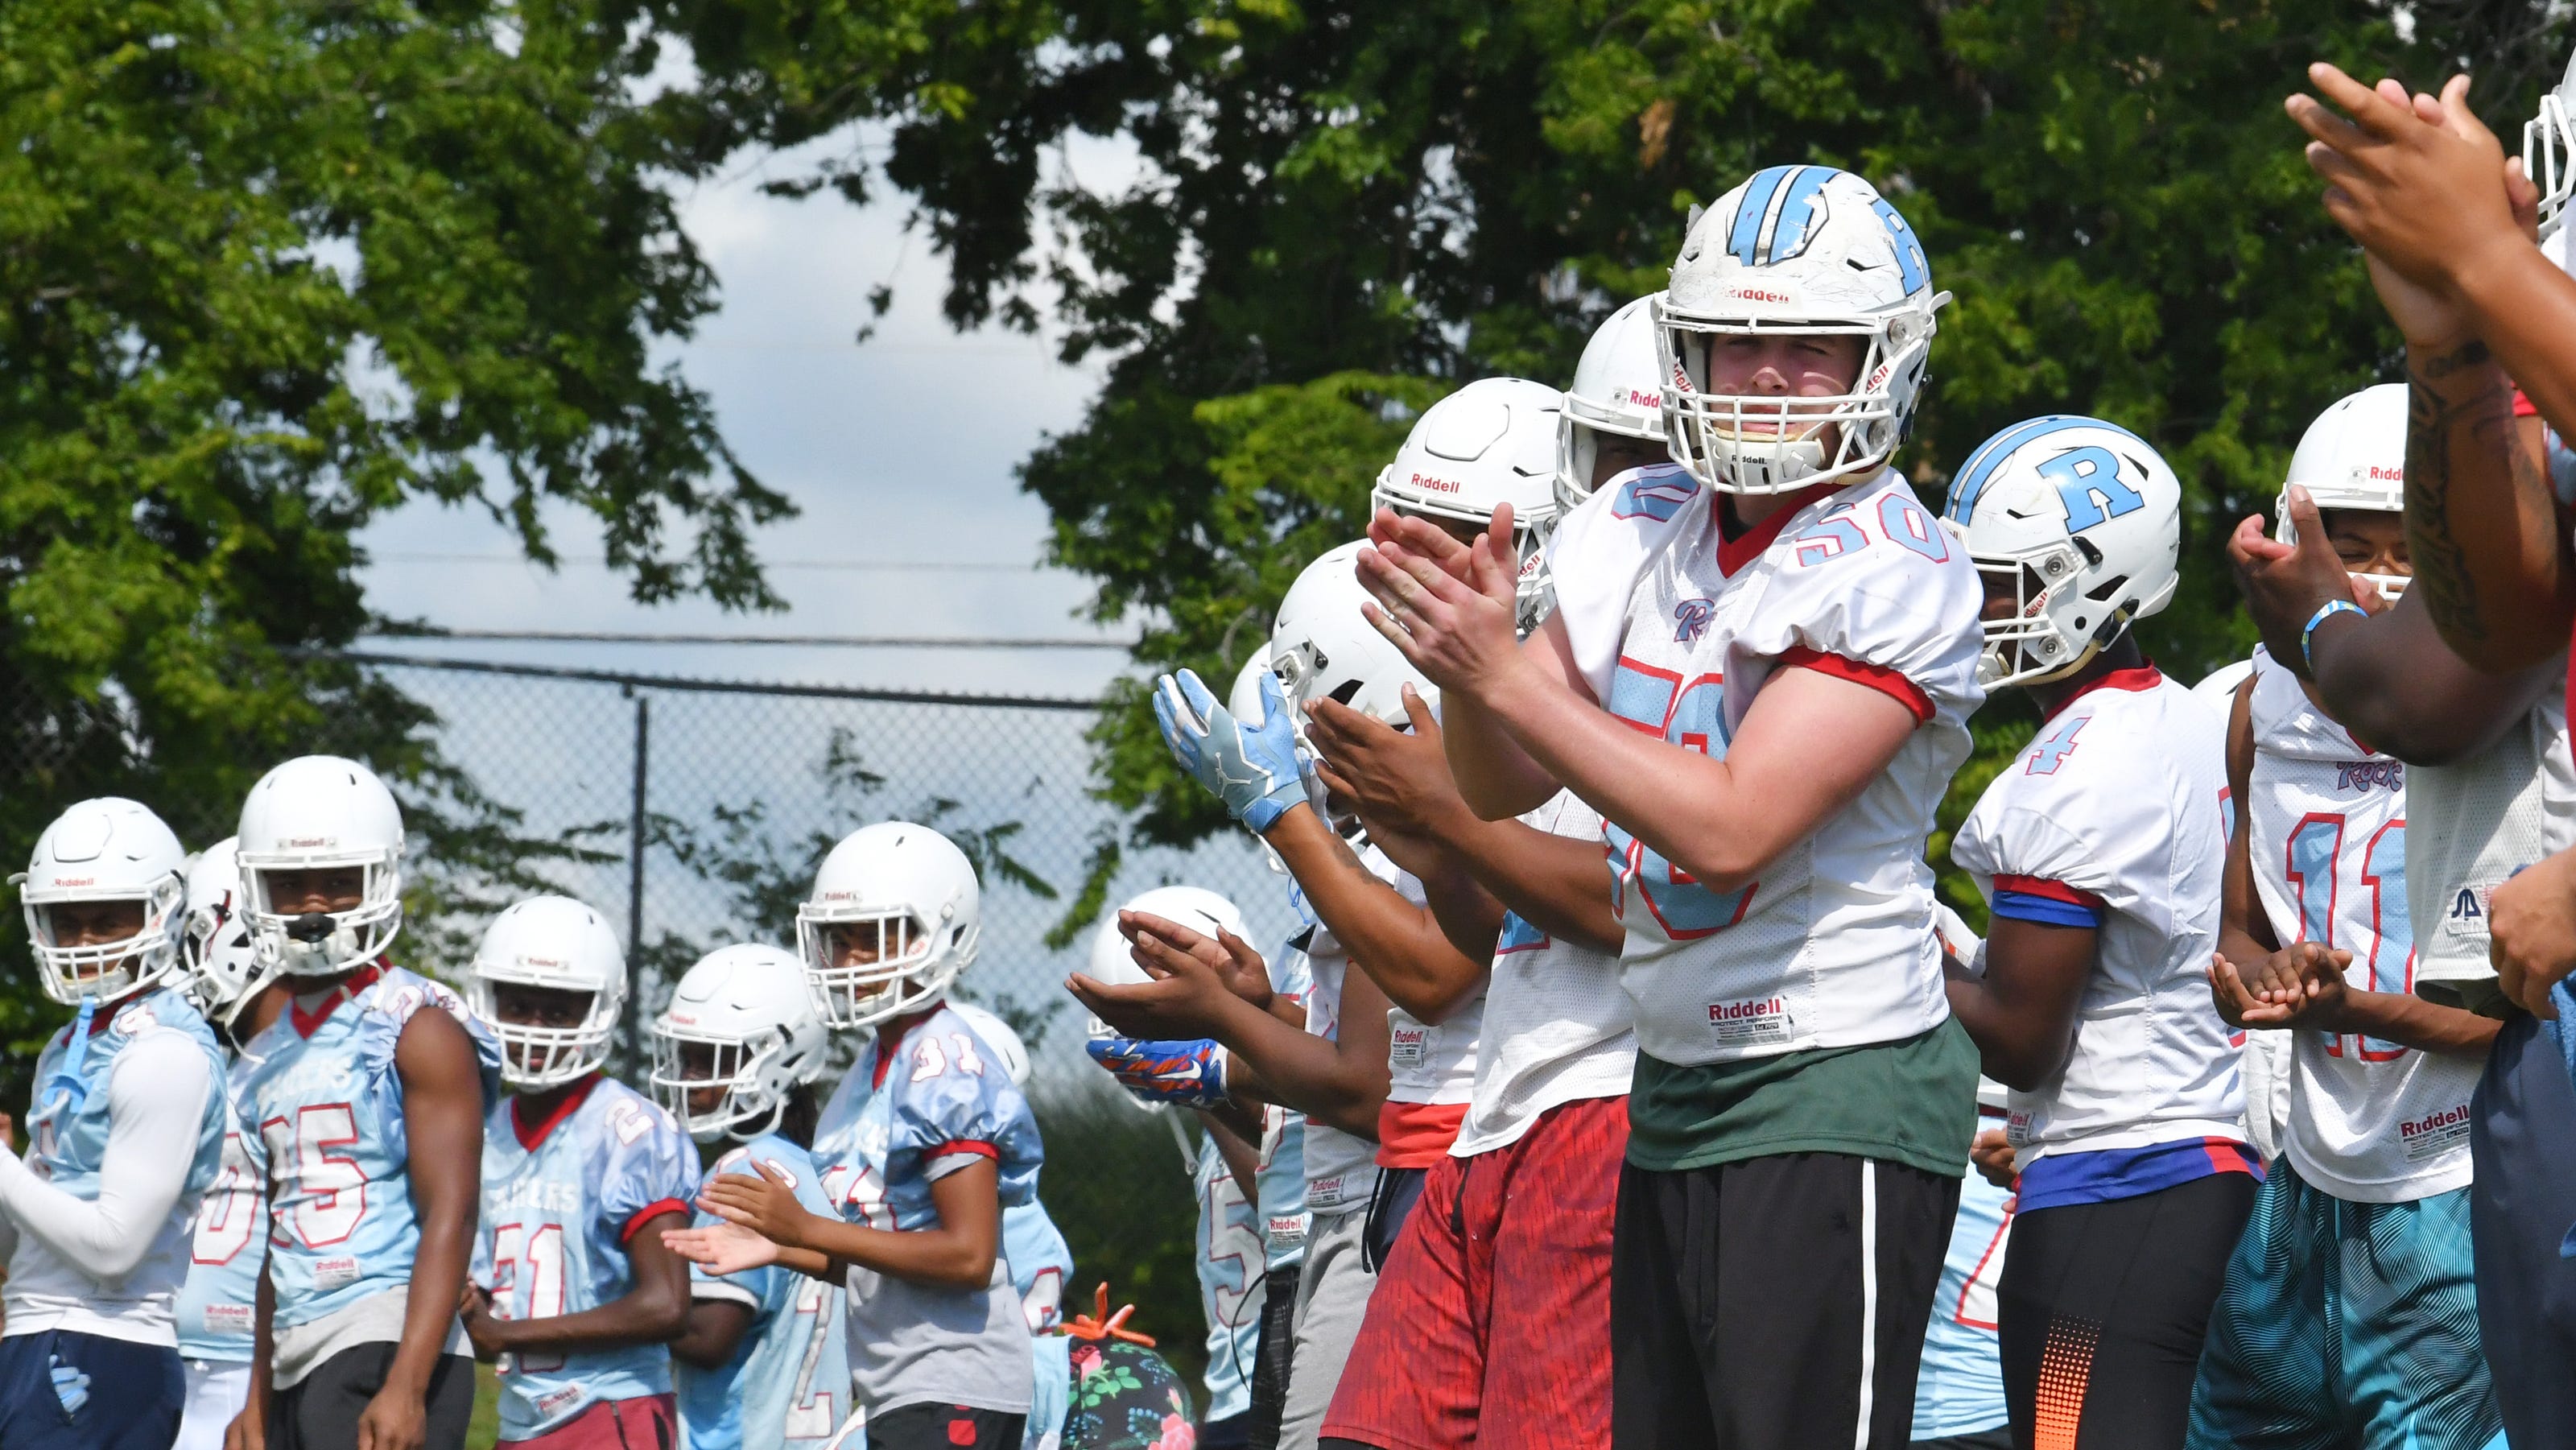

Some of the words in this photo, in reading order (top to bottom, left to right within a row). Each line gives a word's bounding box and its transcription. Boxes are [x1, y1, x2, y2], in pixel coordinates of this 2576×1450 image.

[1630, 390, 1660, 408] Ridd
[1411, 473, 1460, 494] Riddell
[2370, 466, 2401, 481] Ridd
[2036, 446, 2145, 535] R
[2025, 716, 2092, 776] 4
[1708, 998, 1781, 1021] Riddell
[1394, 1030, 1423, 1043] Riddell
[910, 1033, 985, 1083] 31
[2401, 1105, 2470, 1137] Riddell
[1269, 1218, 1302, 1231] Riddell
[206, 1305, 249, 1316] Riddell
